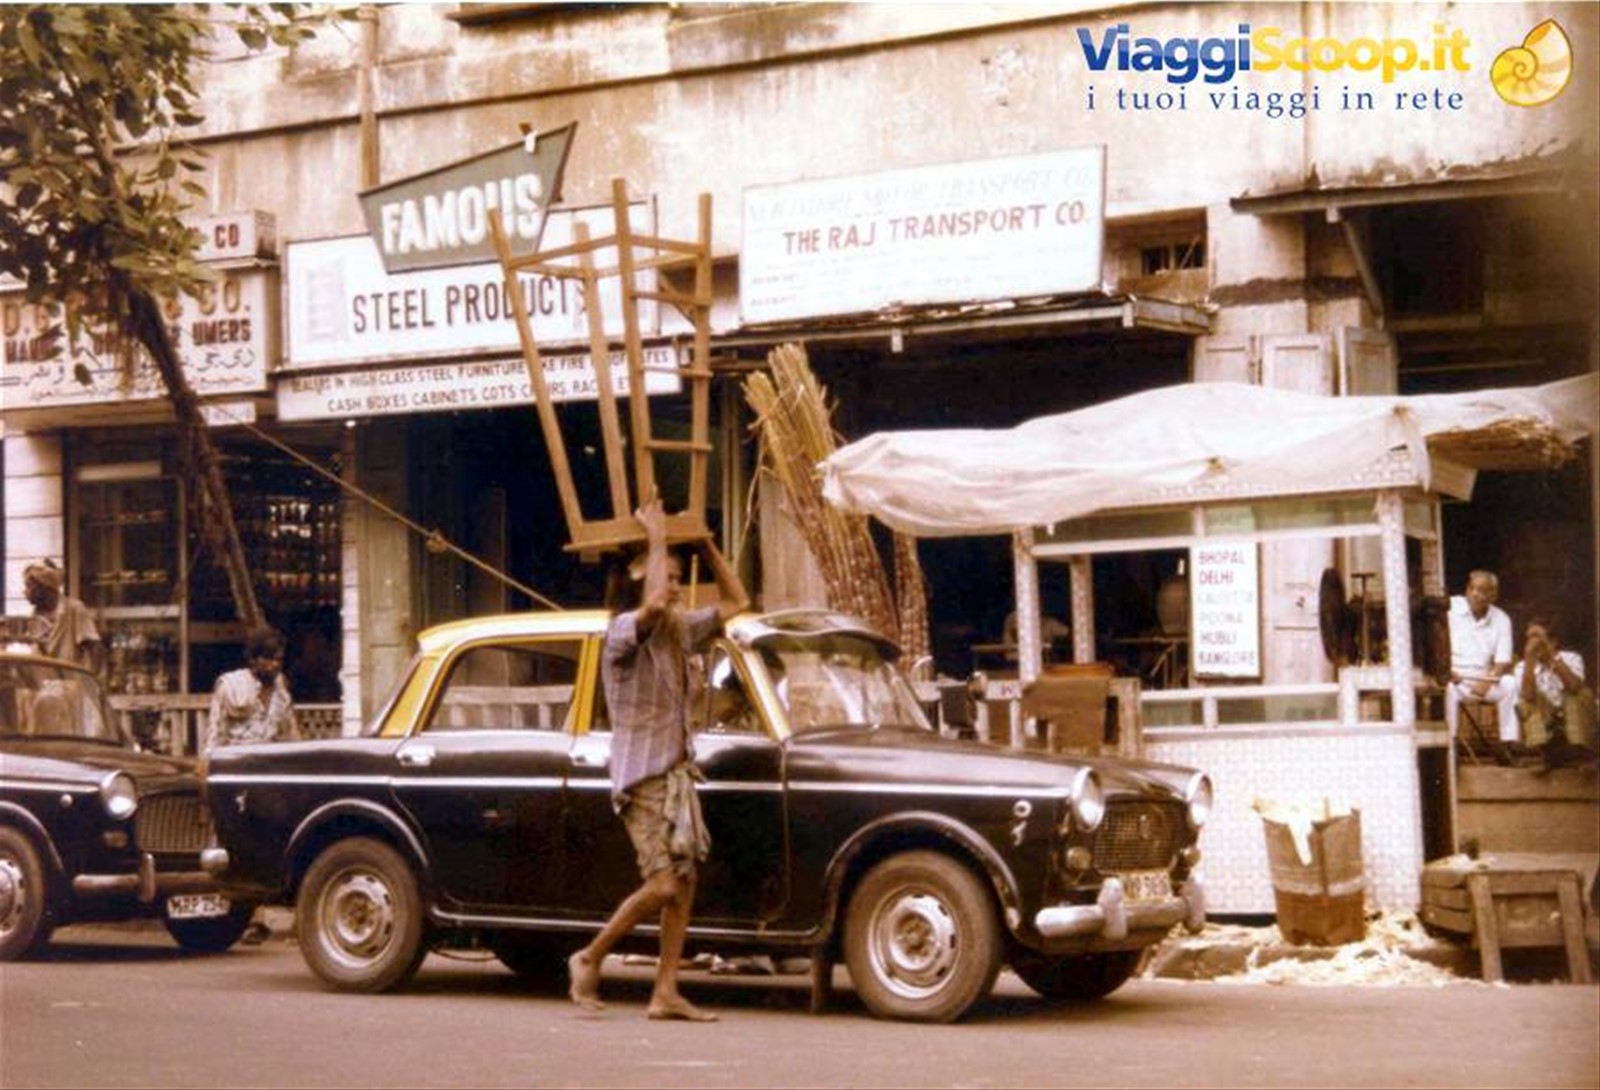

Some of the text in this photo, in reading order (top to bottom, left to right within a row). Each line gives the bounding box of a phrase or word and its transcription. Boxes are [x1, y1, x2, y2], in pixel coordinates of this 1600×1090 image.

[381, 173, 543, 255] FAMOUS
[782, 228, 821, 256] THE
[827, 221, 877, 251] RAJ
[888, 202, 1048, 243] TRANSPORT
[352, 288, 435, 334] STEEL
[379, 369, 413, 385] CLASS
[418, 366, 453, 383] STEEL
[458, 360, 526, 379] FURNITURE
[327, 397, 362, 412] CASH
[366, 392, 408, 410] BOXES
[413, 387, 477, 406] CABINETS
[482, 384, 514, 401] COTS
[1198, 549, 1246, 566] BHOPAL
[1198, 568, 1235, 586] DELHI
[1199, 629, 1237, 646] HUBLI
